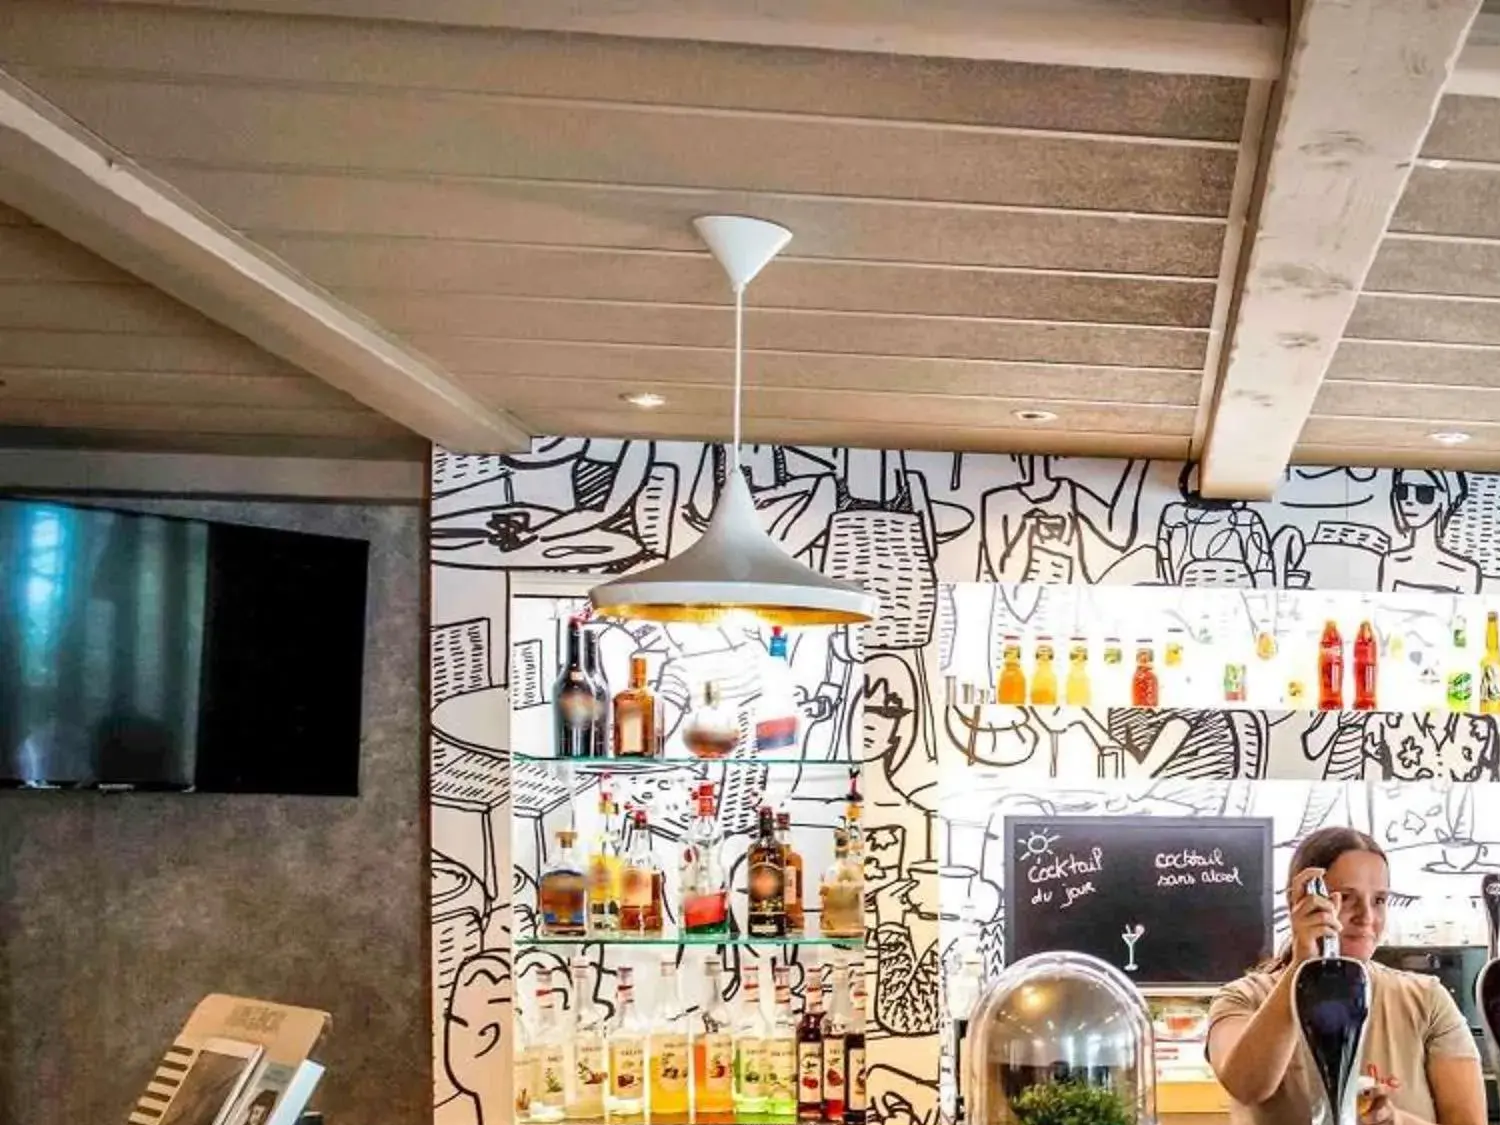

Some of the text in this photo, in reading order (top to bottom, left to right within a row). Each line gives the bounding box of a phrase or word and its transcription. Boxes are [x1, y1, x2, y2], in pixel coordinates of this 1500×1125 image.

[1157, 873, 1195, 887] sans
[1031, 881, 1096, 908] du jour
